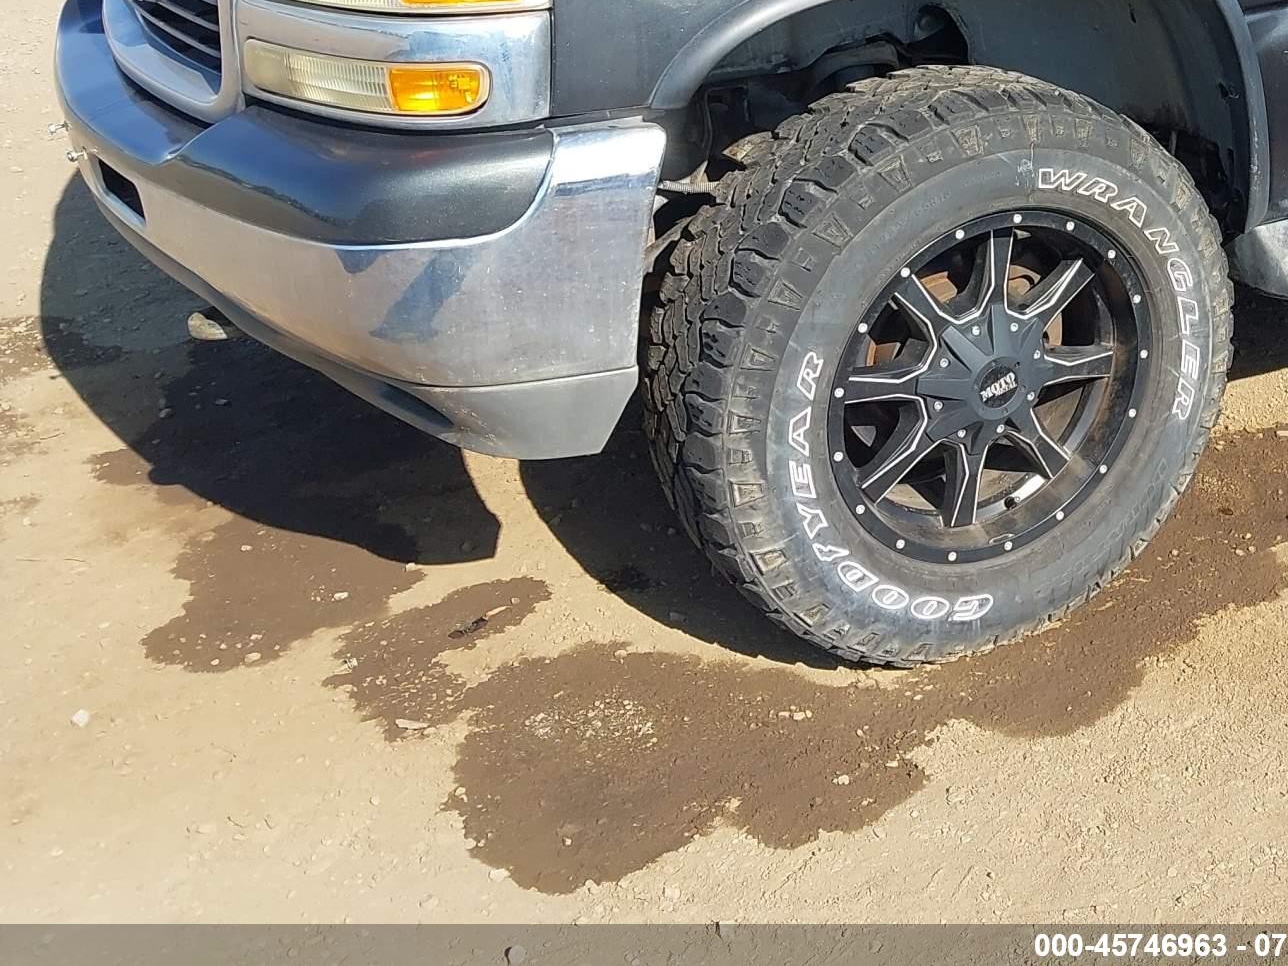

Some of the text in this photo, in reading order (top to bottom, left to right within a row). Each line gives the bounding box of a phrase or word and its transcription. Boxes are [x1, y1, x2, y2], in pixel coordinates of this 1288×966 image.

[979, 371, 1015, 401] MOTO
[1038, 166, 1210, 422] WRANGLER
[785, 350, 995, 622] GOODYEAR
